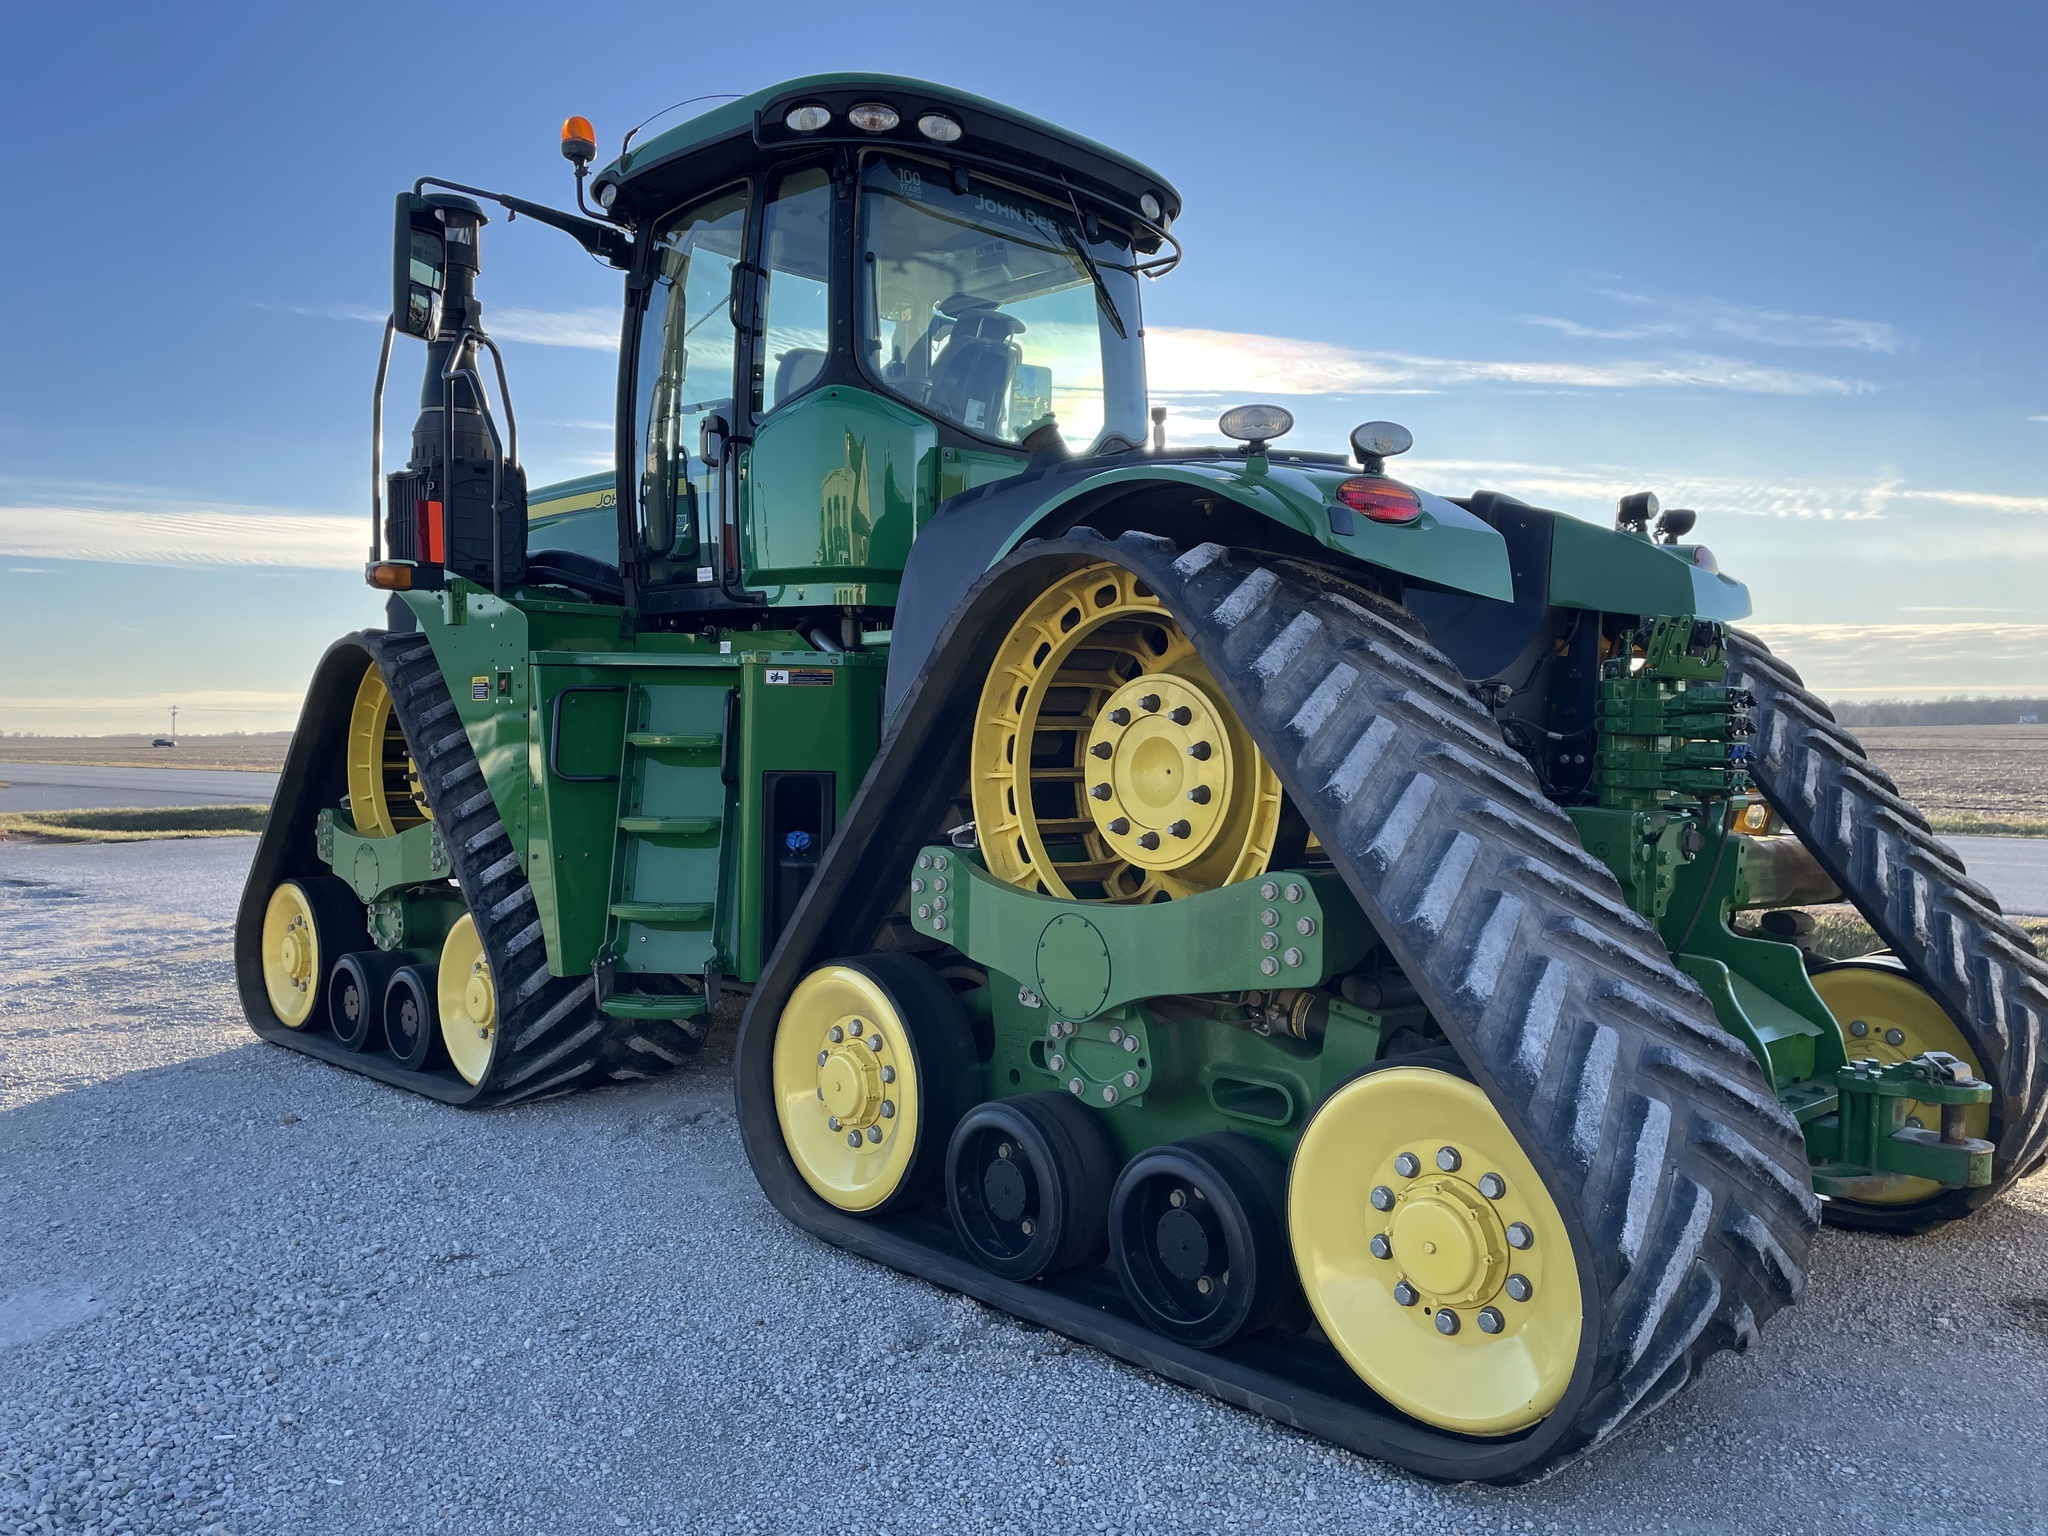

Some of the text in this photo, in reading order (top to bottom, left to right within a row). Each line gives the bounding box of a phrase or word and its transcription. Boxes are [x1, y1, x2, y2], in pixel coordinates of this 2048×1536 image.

[898, 168, 921, 186] 100
[899, 182, 922, 195] YEARS
[974, 193, 1077, 236] JOHN DEE
[596, 493, 617, 506] JOH
